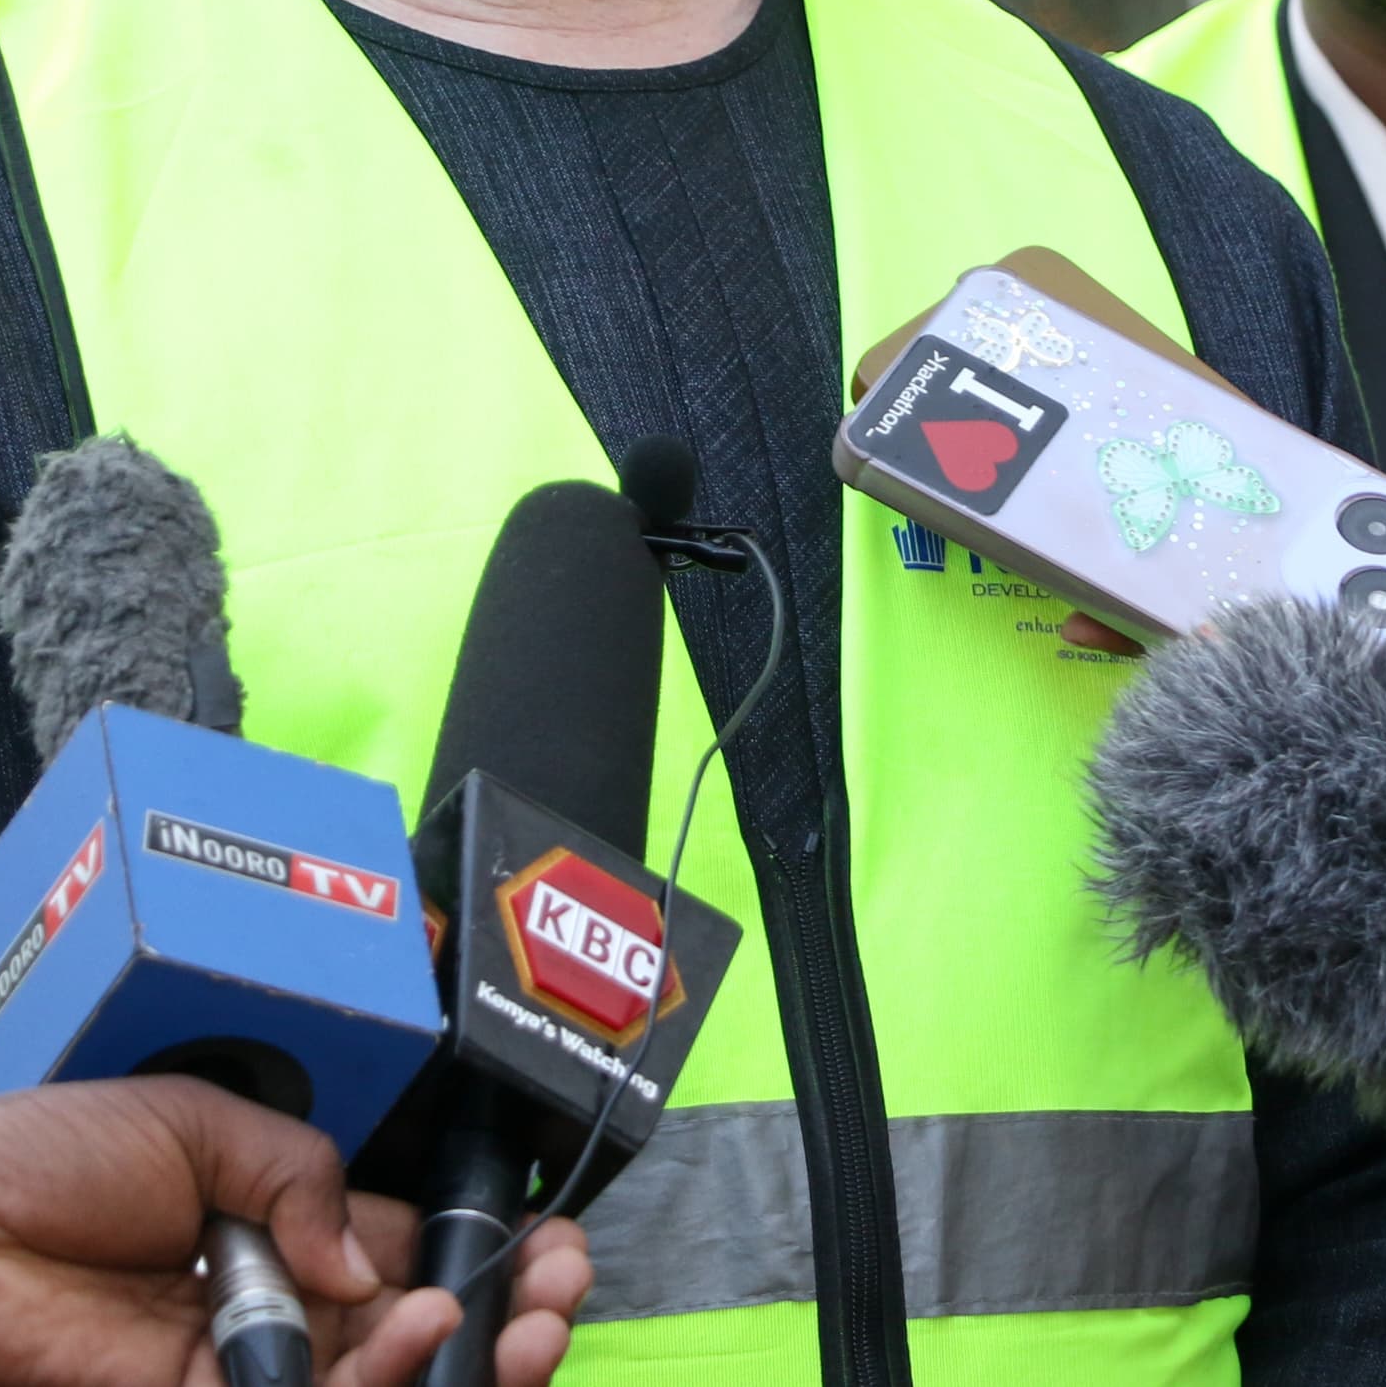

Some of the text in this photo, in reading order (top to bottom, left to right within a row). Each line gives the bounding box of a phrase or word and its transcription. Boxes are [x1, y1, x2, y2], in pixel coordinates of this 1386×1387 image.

[49, 838, 97, 918] TV
[299, 860, 387, 909] TV
[536, 890, 656, 988] KBC
[560, 1026, 658, 1099] Watchng
